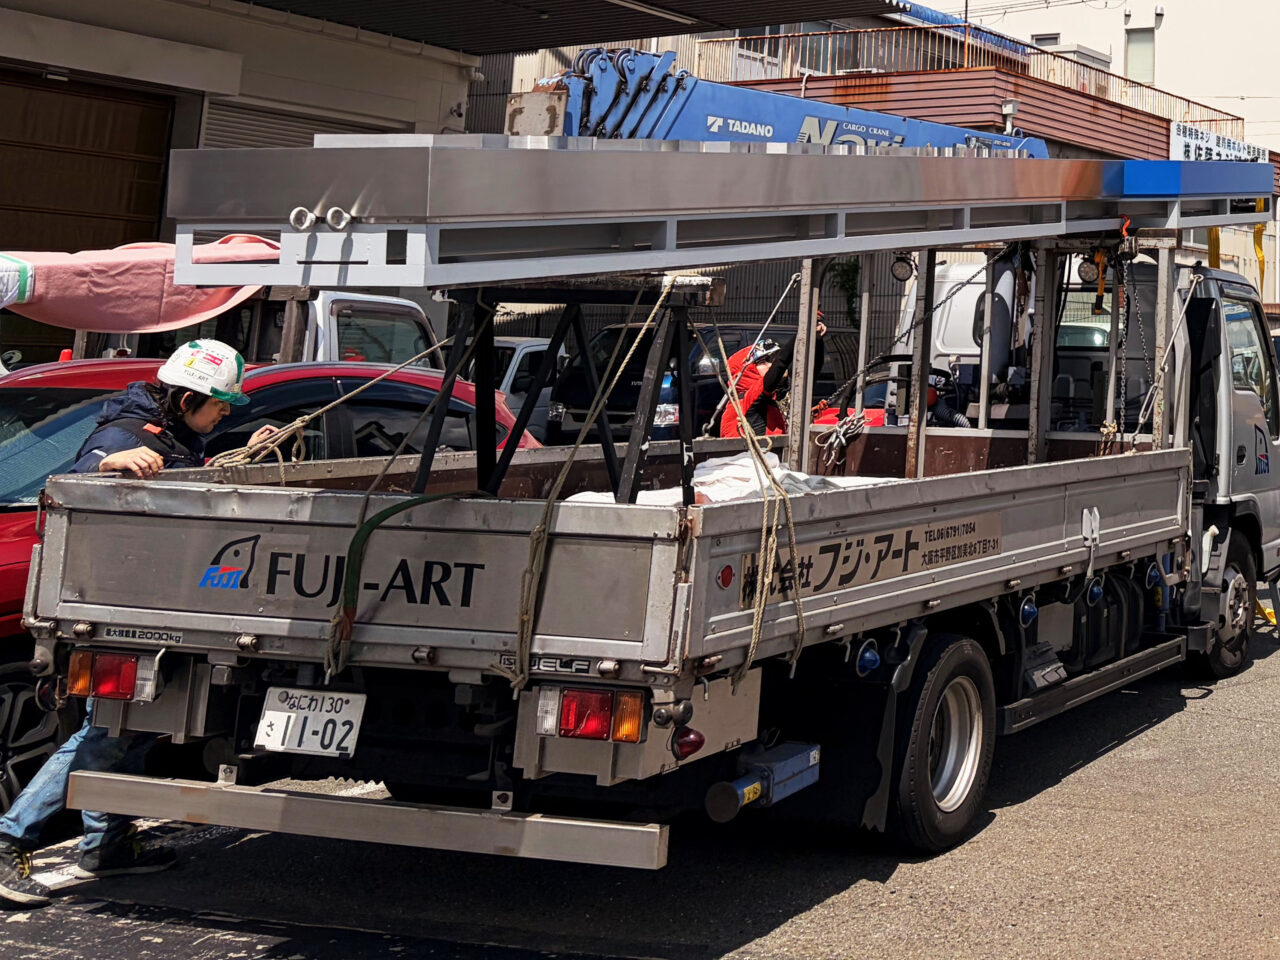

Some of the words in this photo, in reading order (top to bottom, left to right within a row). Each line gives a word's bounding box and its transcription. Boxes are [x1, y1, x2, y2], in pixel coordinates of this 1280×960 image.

[727, 119, 774, 138] TADANO
[842, 122, 866, 133] CARGO
[868, 127, 890, 137] CRANE
[265, 551, 486, 608] FUJ-ART
[539, 658, 589, 673] ELF
[281, 715, 354, 752] 11-02
